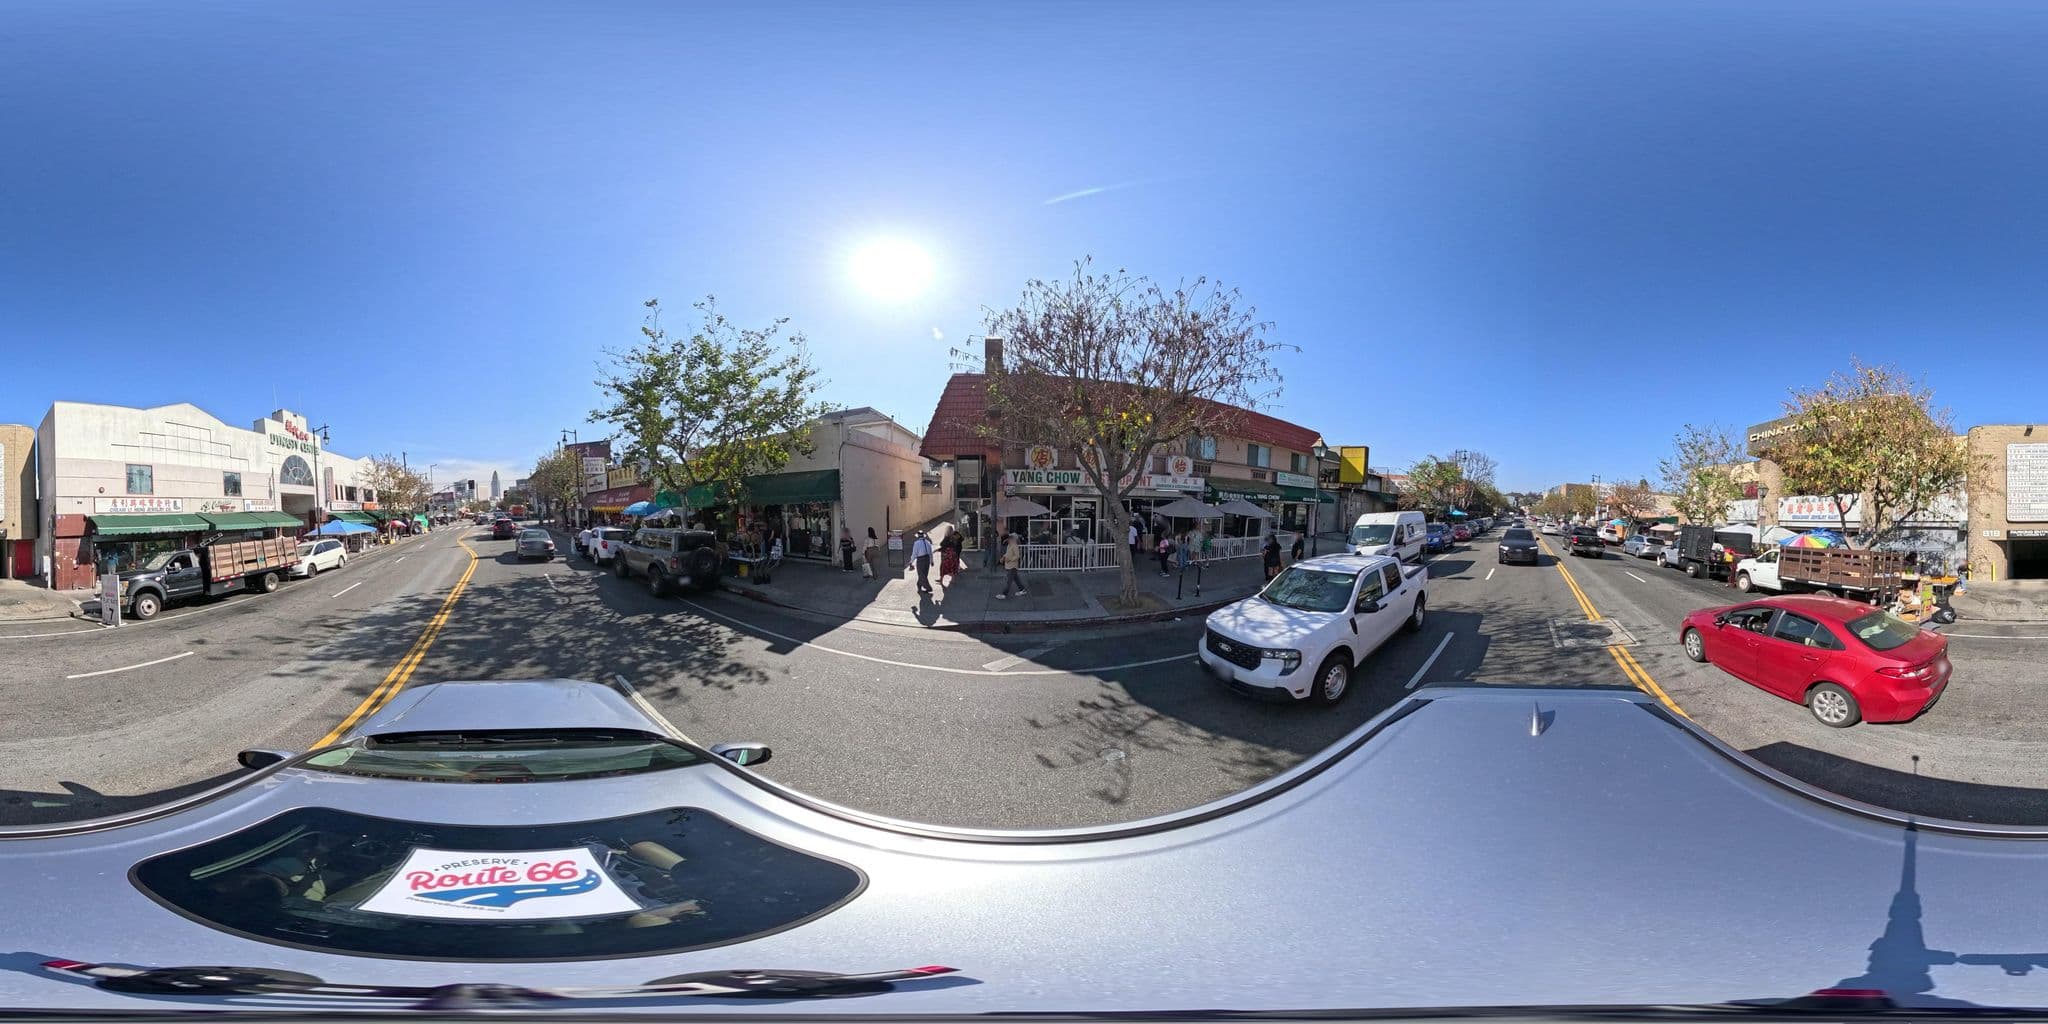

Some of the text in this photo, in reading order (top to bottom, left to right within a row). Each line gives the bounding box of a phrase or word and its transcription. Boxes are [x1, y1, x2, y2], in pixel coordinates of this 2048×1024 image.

[1012, 471, 1042, 483] YANG
[1046, 471, 1080, 484] CHOW
[441, 858, 520, 870] PRESERVE
[405, 860, 579, 891] Route 66
